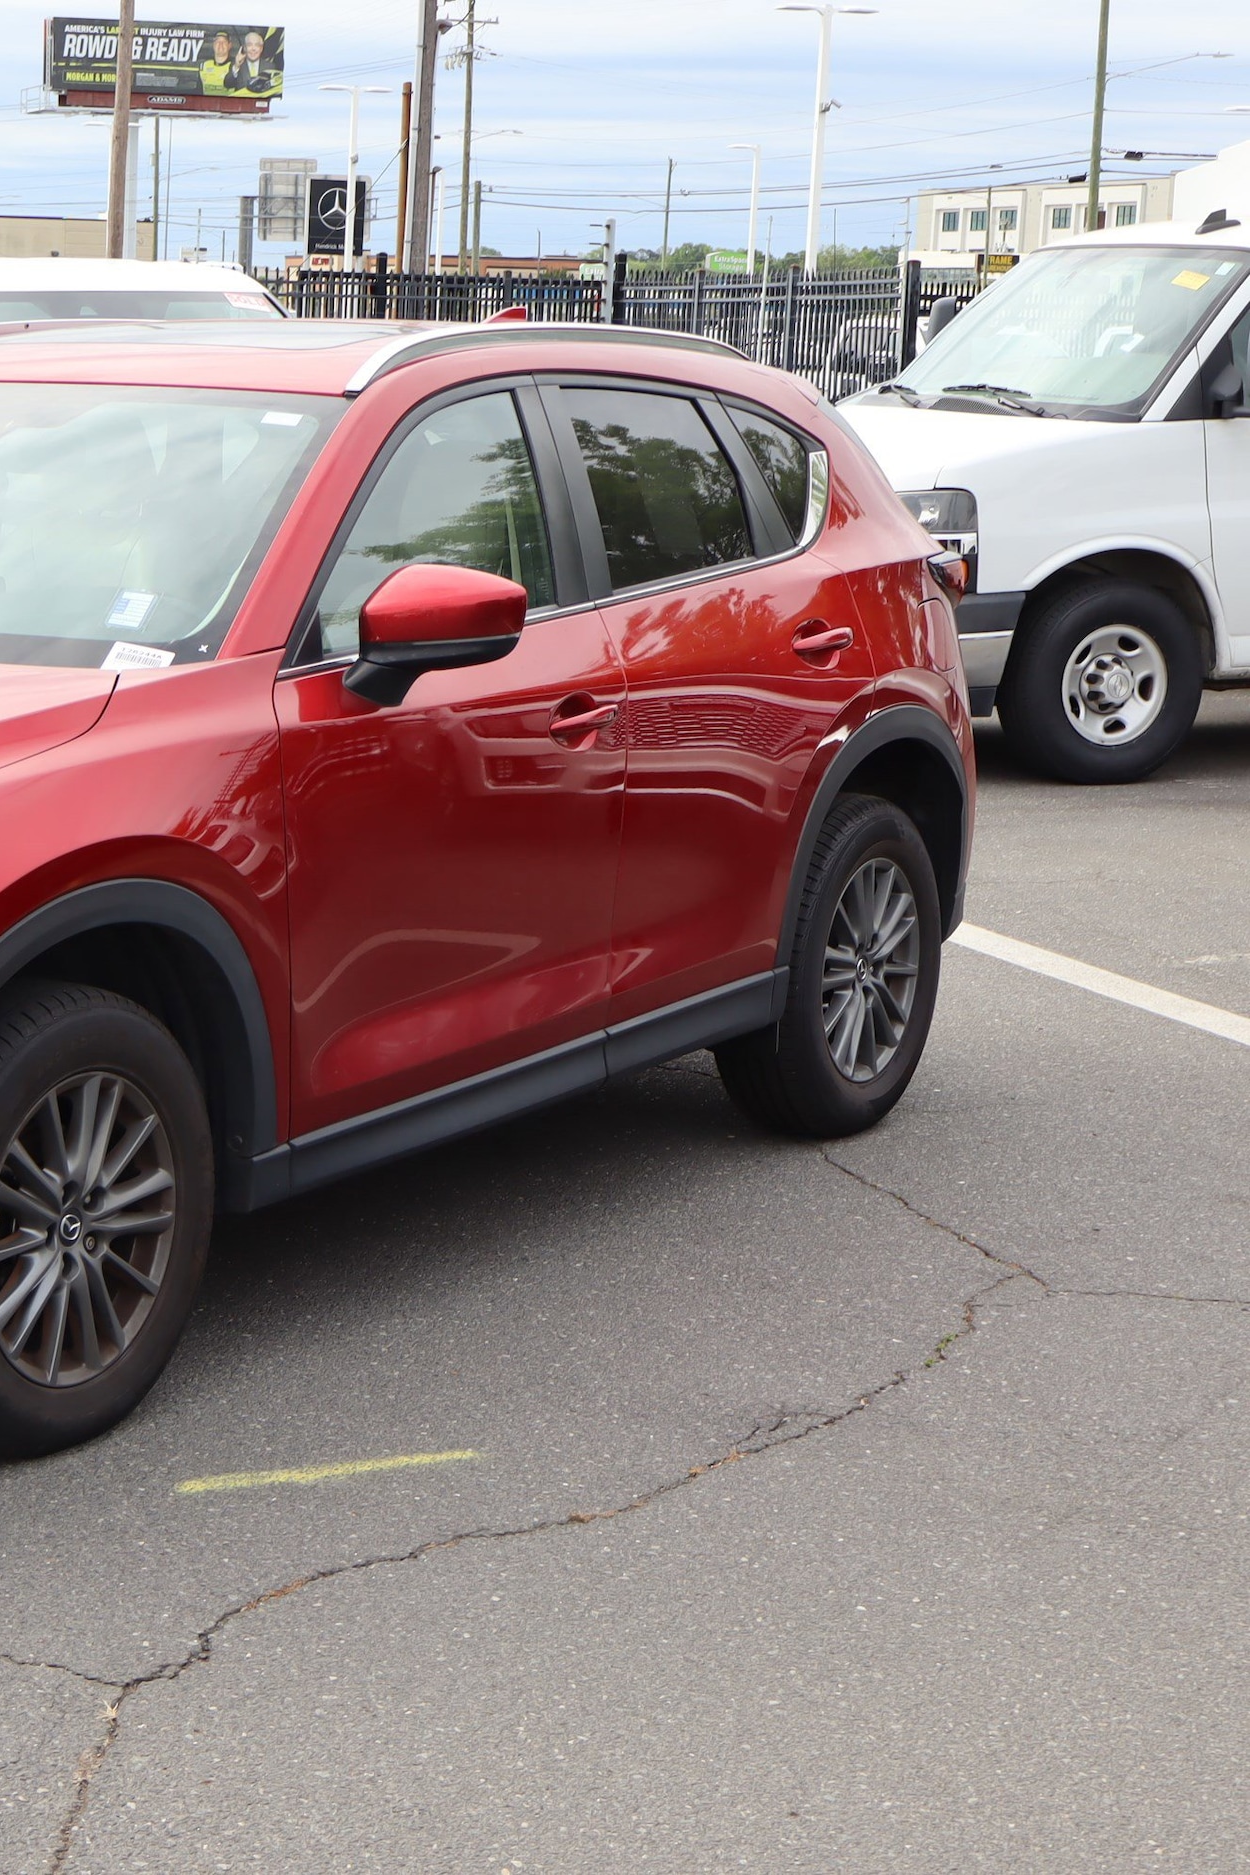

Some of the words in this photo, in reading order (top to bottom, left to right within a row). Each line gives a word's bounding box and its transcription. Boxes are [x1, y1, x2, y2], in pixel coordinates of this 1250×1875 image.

[64, 24, 105, 34] AMERICA'S
[140, 27, 167, 37] INJURY
[168, 29, 185, 38] LAW
[186, 30, 205, 38] FIRM
[62, 33, 118, 59] ROWD
[144, 37, 205, 62] READY
[65, 71, 95, 82] MORGAN
[95, 73, 101, 82] &
[150, 96, 184, 104] ADAMS
